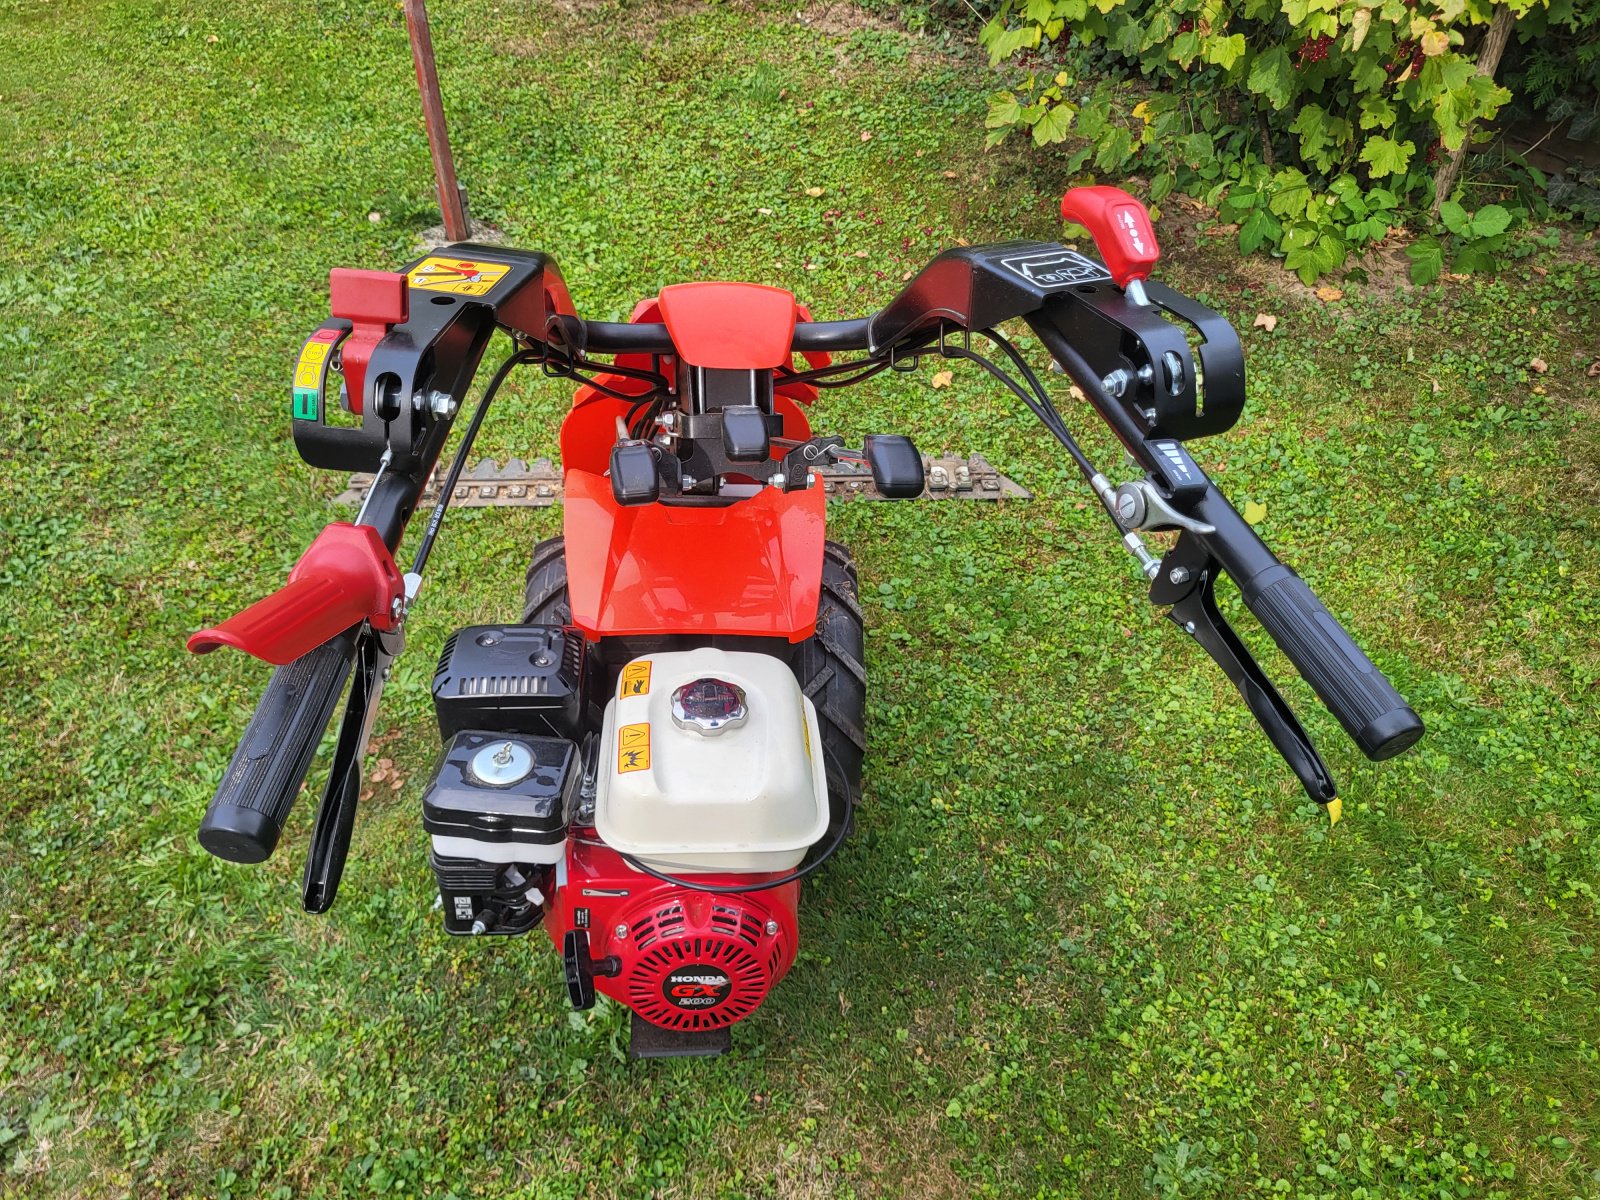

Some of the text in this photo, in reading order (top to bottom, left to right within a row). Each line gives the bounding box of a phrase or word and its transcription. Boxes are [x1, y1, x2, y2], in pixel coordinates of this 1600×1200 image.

[671, 975, 727, 984] HONDA
[671, 984, 721, 997] GX
[678, 997, 716, 1006] 200
